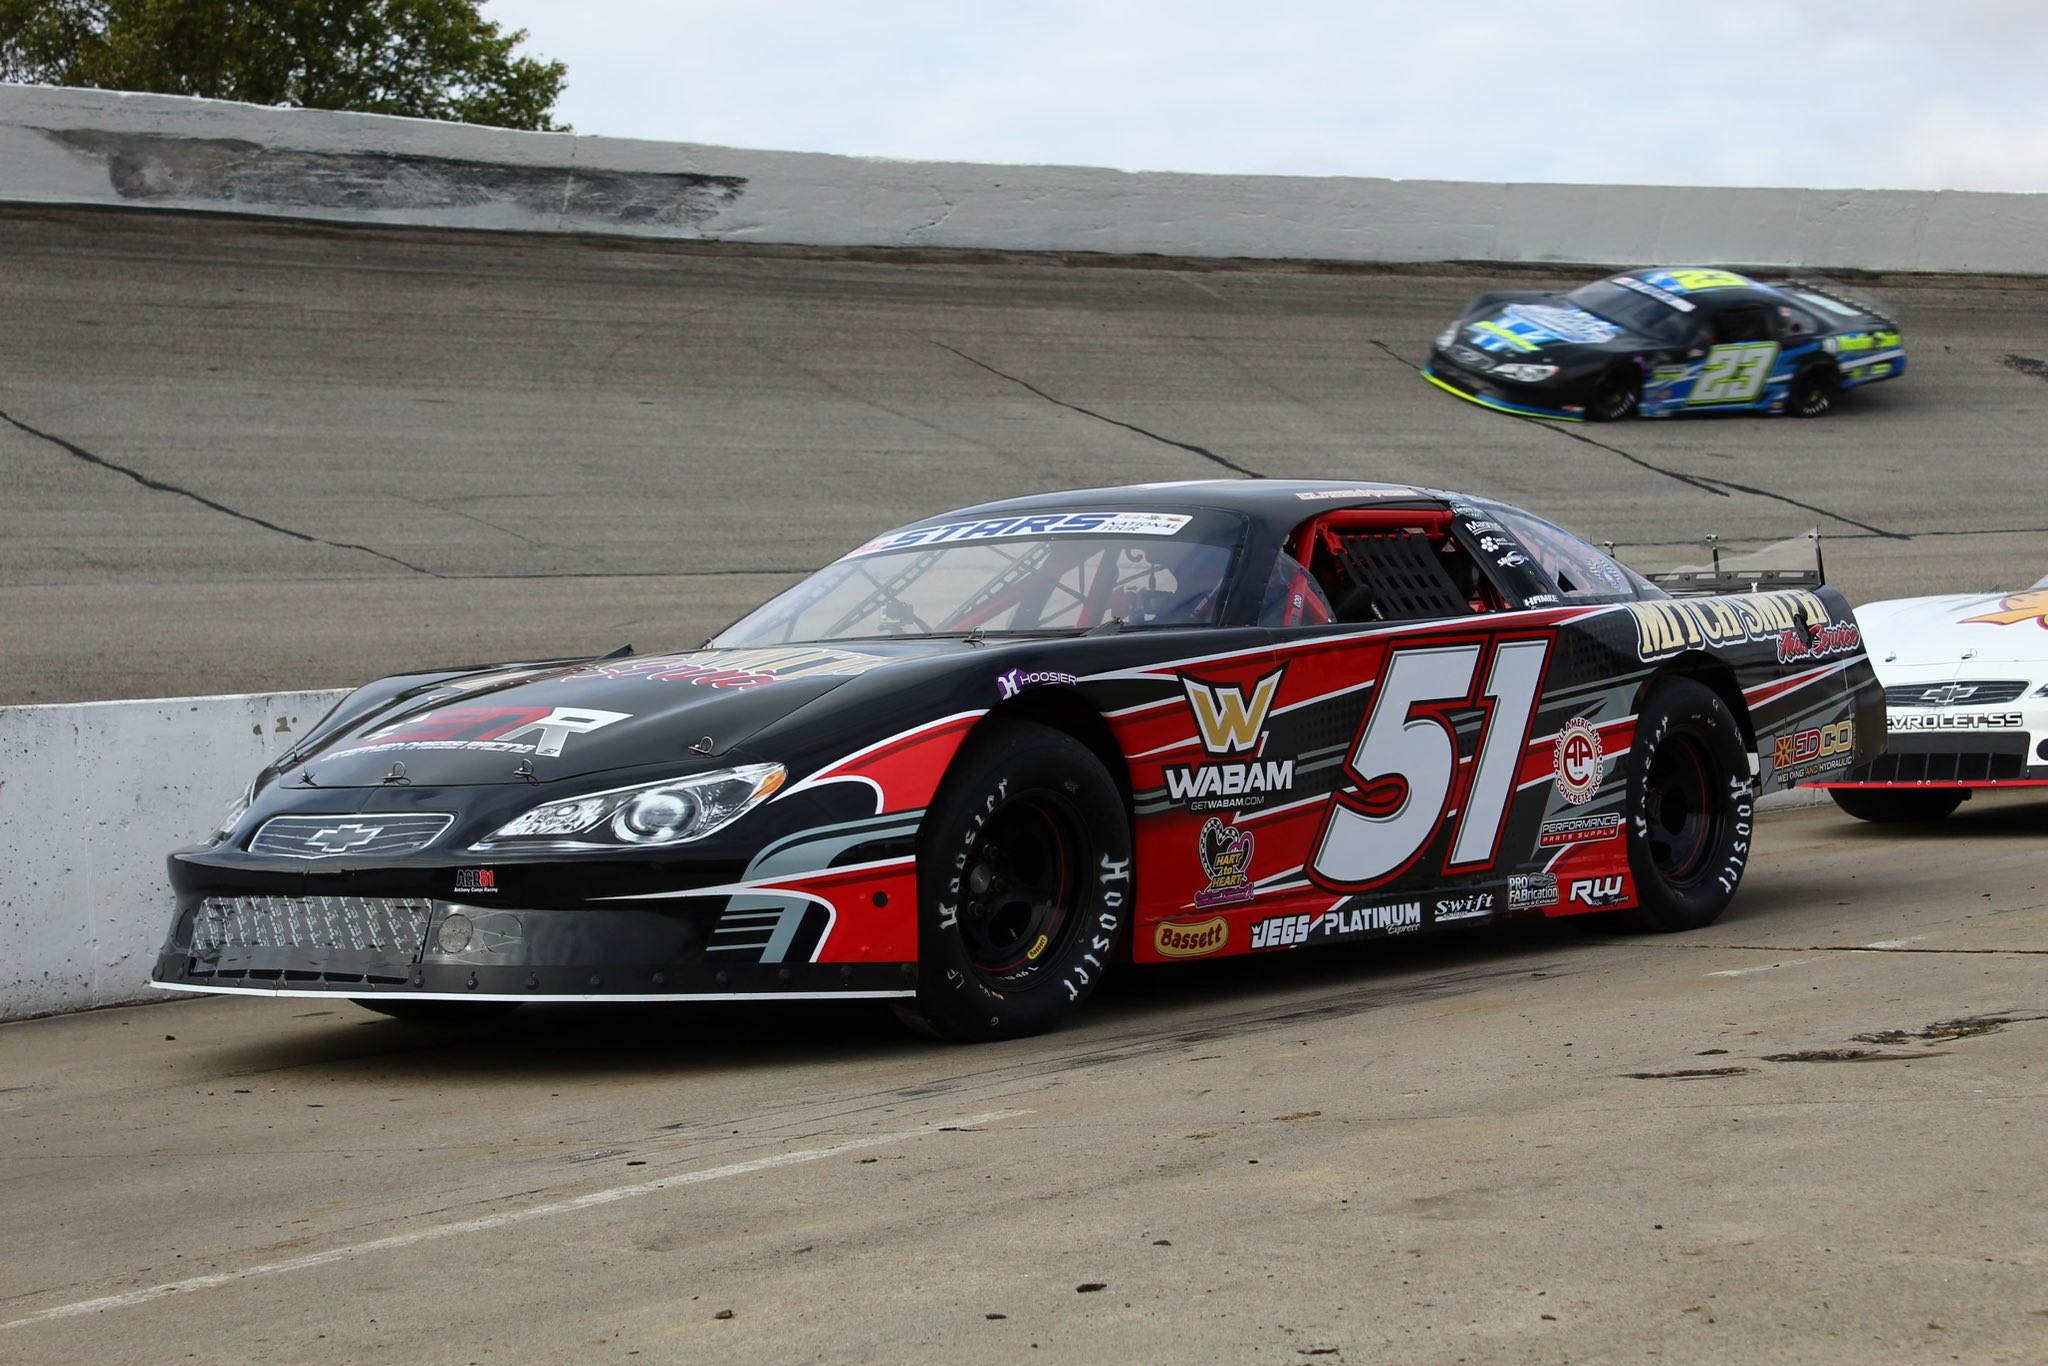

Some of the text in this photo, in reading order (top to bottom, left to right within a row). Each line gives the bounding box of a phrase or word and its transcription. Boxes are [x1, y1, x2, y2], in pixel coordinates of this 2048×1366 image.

[1688, 342, 1778, 403] 23
[880, 514, 1122, 549] STARS
[1107, 521, 1178, 530] NATIONAL
[1631, 596, 1743, 654] MITCH
[1019, 671, 1078, 687] HOOSIER
[1886, 712, 1984, 730] EVROLET
[1566, 717, 1601, 746] AMERICAN
[460, 741, 537, 754] RACING
[1792, 719, 1853, 765] EDCO
[1312, 638, 1550, 884] 51
[1819, 755, 1853, 772] HYDRAULIC
[1165, 760, 1293, 800] WABAM
[1190, 795, 1265, 811] GETWABAM.COM
[1542, 815, 1618, 834] PERFORMANCE
[1543, 827, 1616, 844] PARTS SUPPLY
[1215, 852, 1242, 867] HART
[1223, 866, 1233, 876] to
[1211, 875, 1243, 889] HEART
[1509, 876, 1528, 890] PRO
[1509, 886, 1558, 904] FABrication
[1063, 851, 1131, 1002] Hoosier
[1323, 902, 1421, 935] PLATINUM
[1160, 923, 1223, 951] Bassett
[1251, 914, 1311, 949] JEGS
